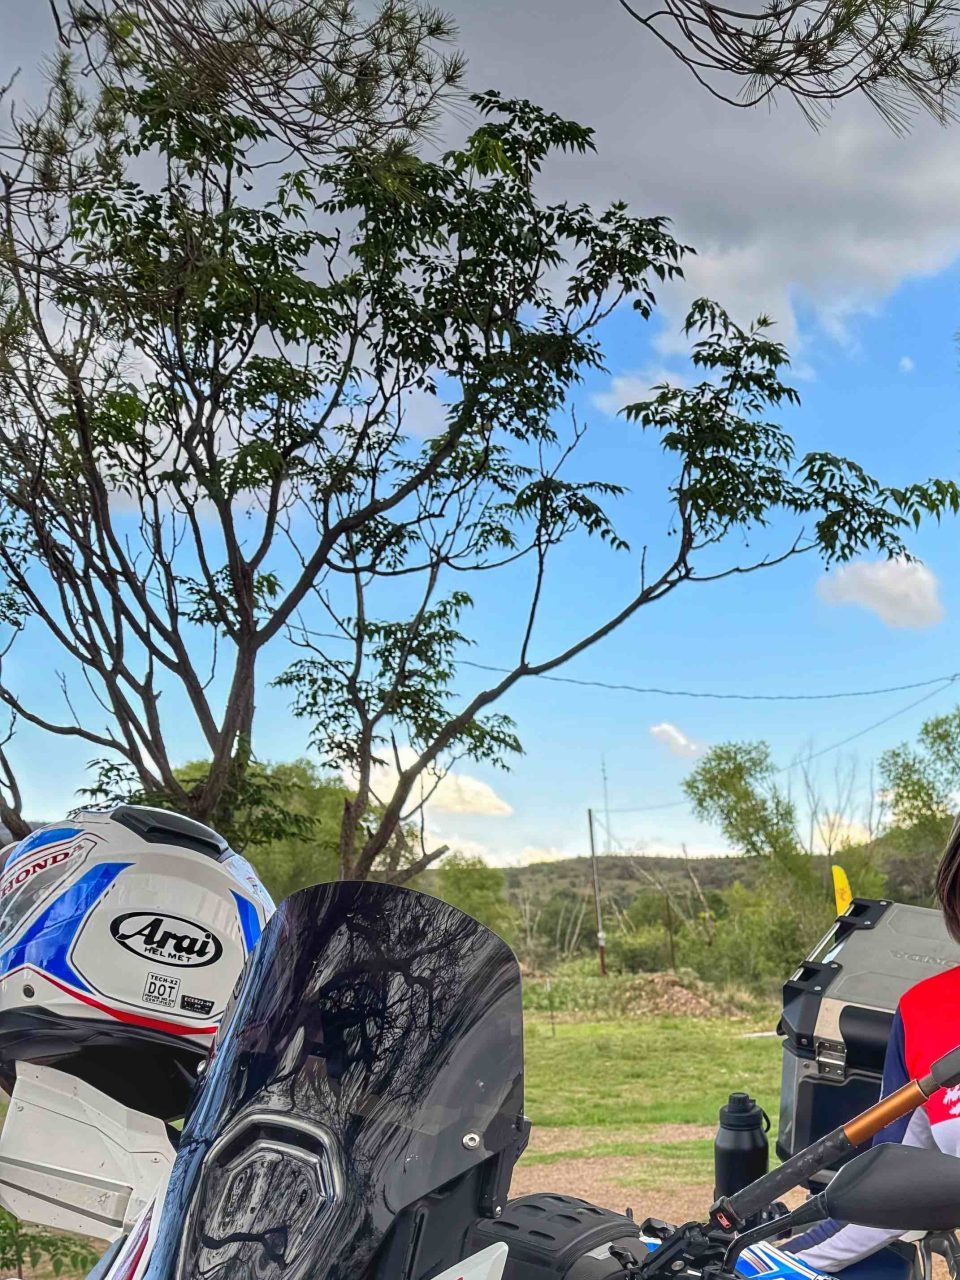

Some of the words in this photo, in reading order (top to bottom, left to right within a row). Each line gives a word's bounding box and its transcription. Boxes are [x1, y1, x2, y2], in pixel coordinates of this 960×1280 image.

[1, 844, 84, 899] HONDA
[116, 918, 210, 957] Arai
[144, 947, 192, 963] HELMET
[150, 974, 178, 986] TECH-X2
[148, 982, 176, 999] DOT
